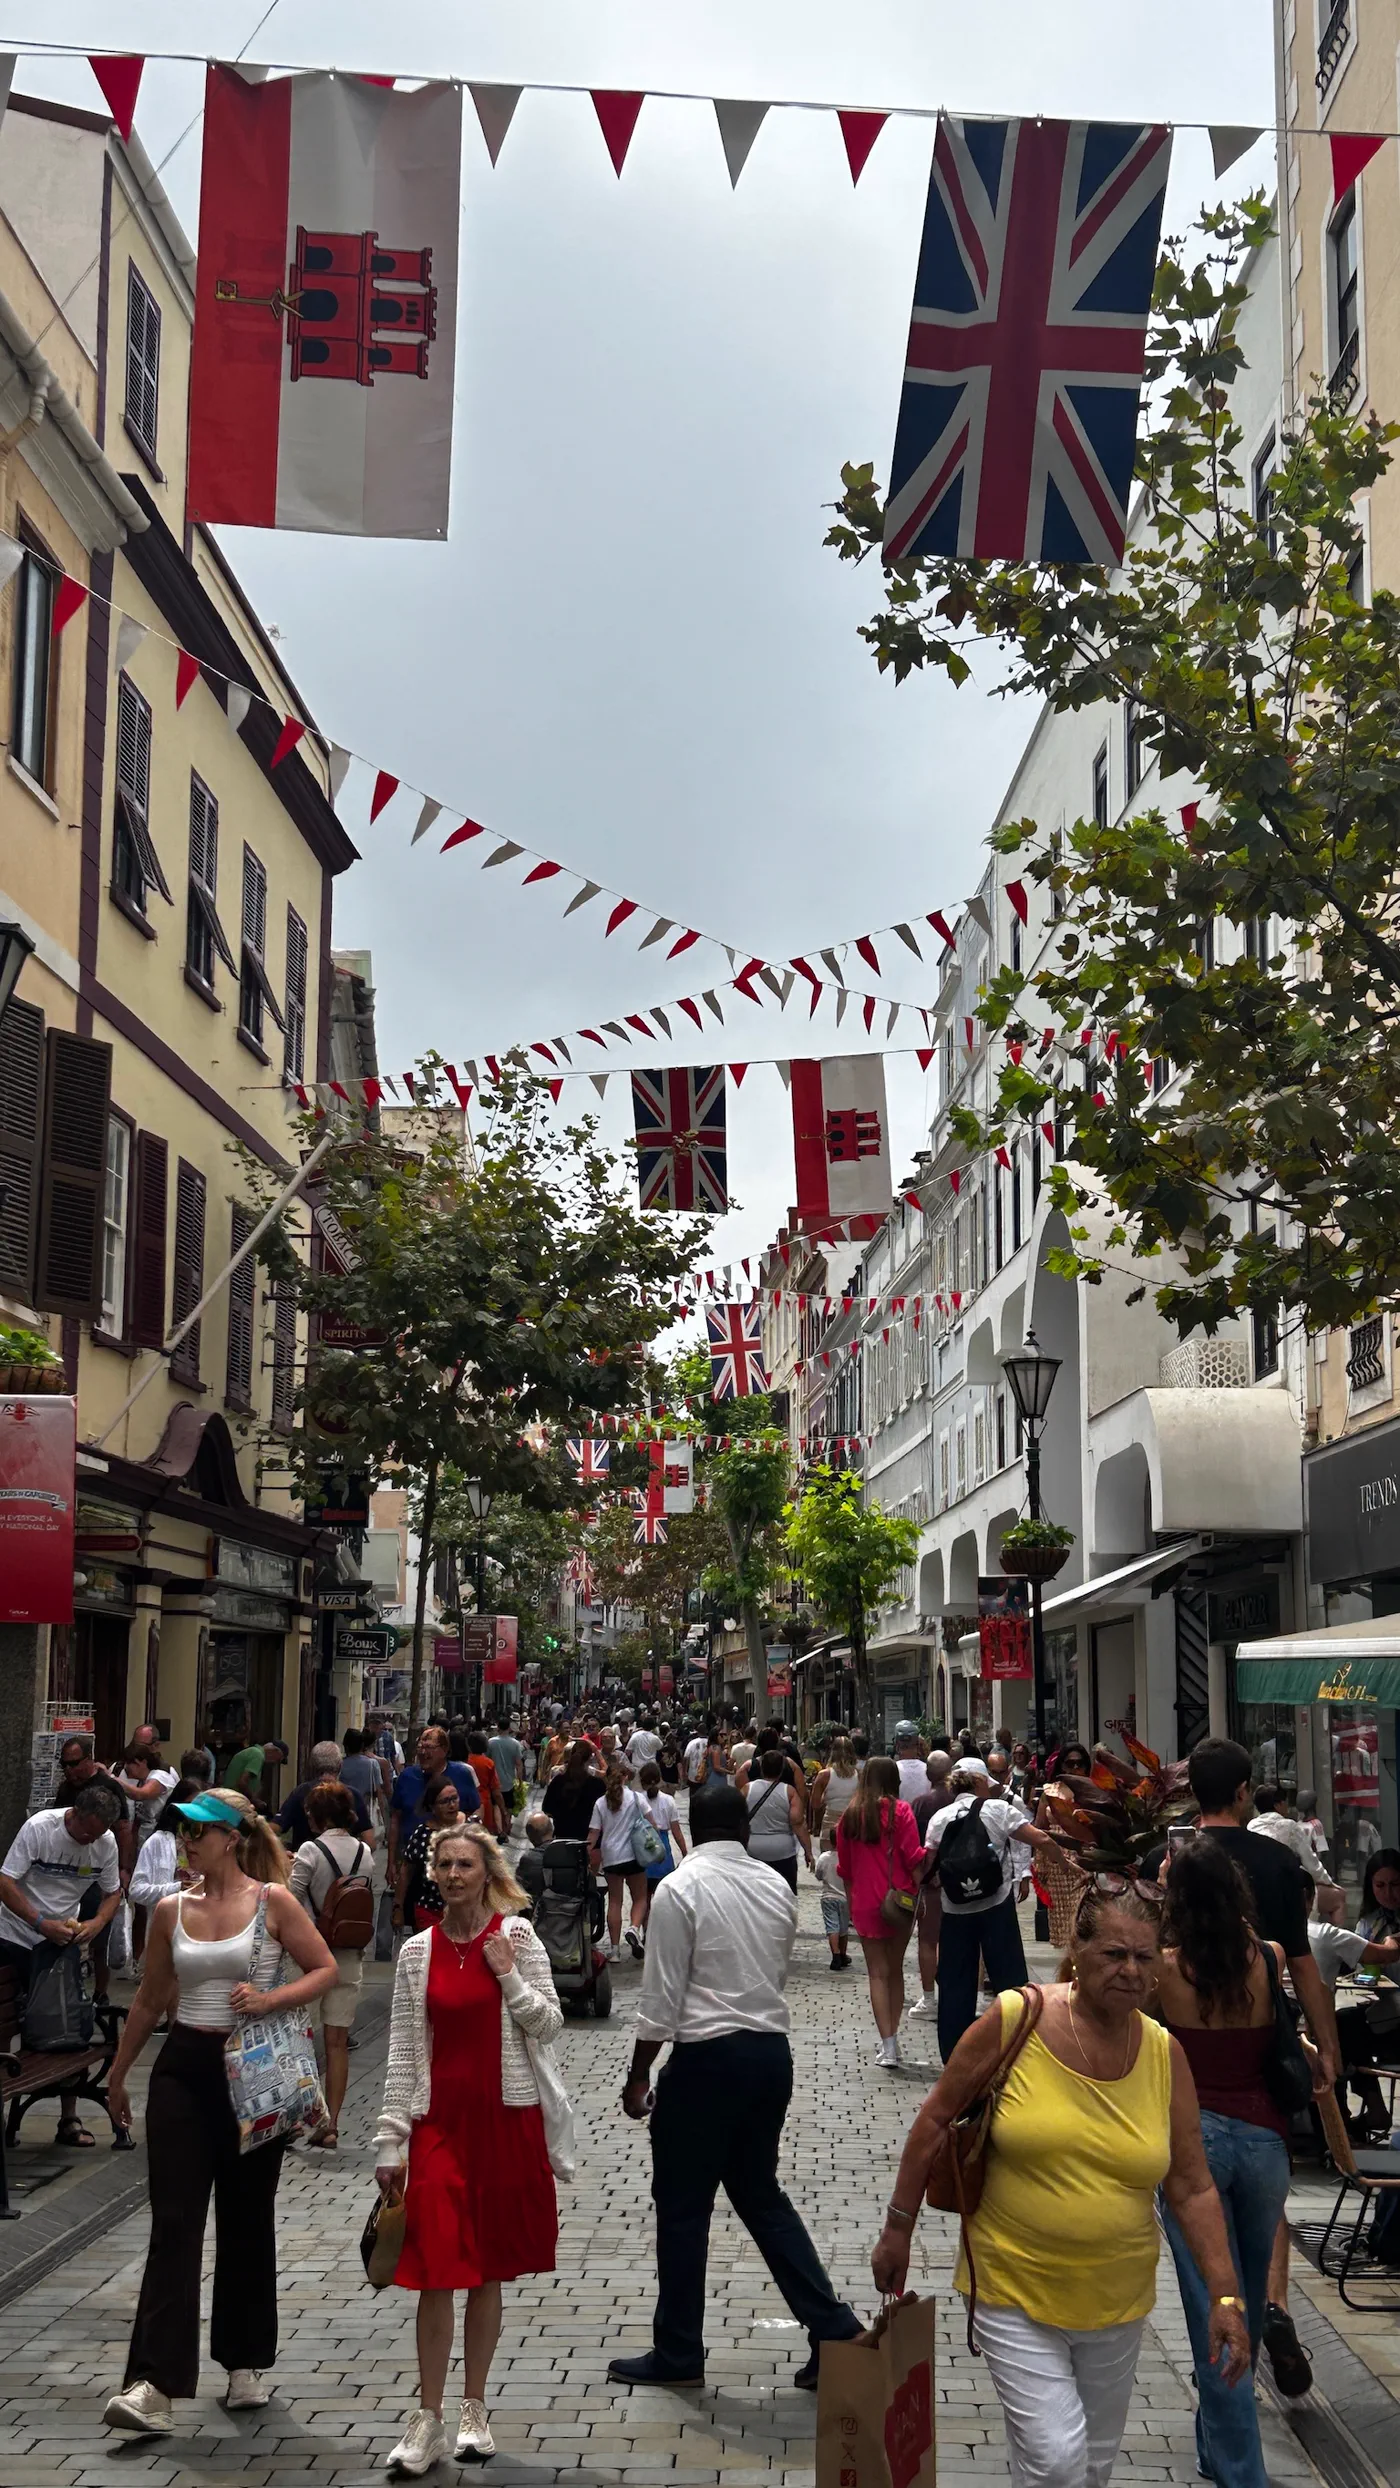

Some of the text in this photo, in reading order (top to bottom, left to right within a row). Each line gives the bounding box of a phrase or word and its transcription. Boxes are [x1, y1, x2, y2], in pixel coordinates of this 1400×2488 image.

[324, 1329, 367, 1338] SPIRITS
[6, 1523, 45, 1531] NATIONAL
[323, 1596, 350, 1606] VISA
